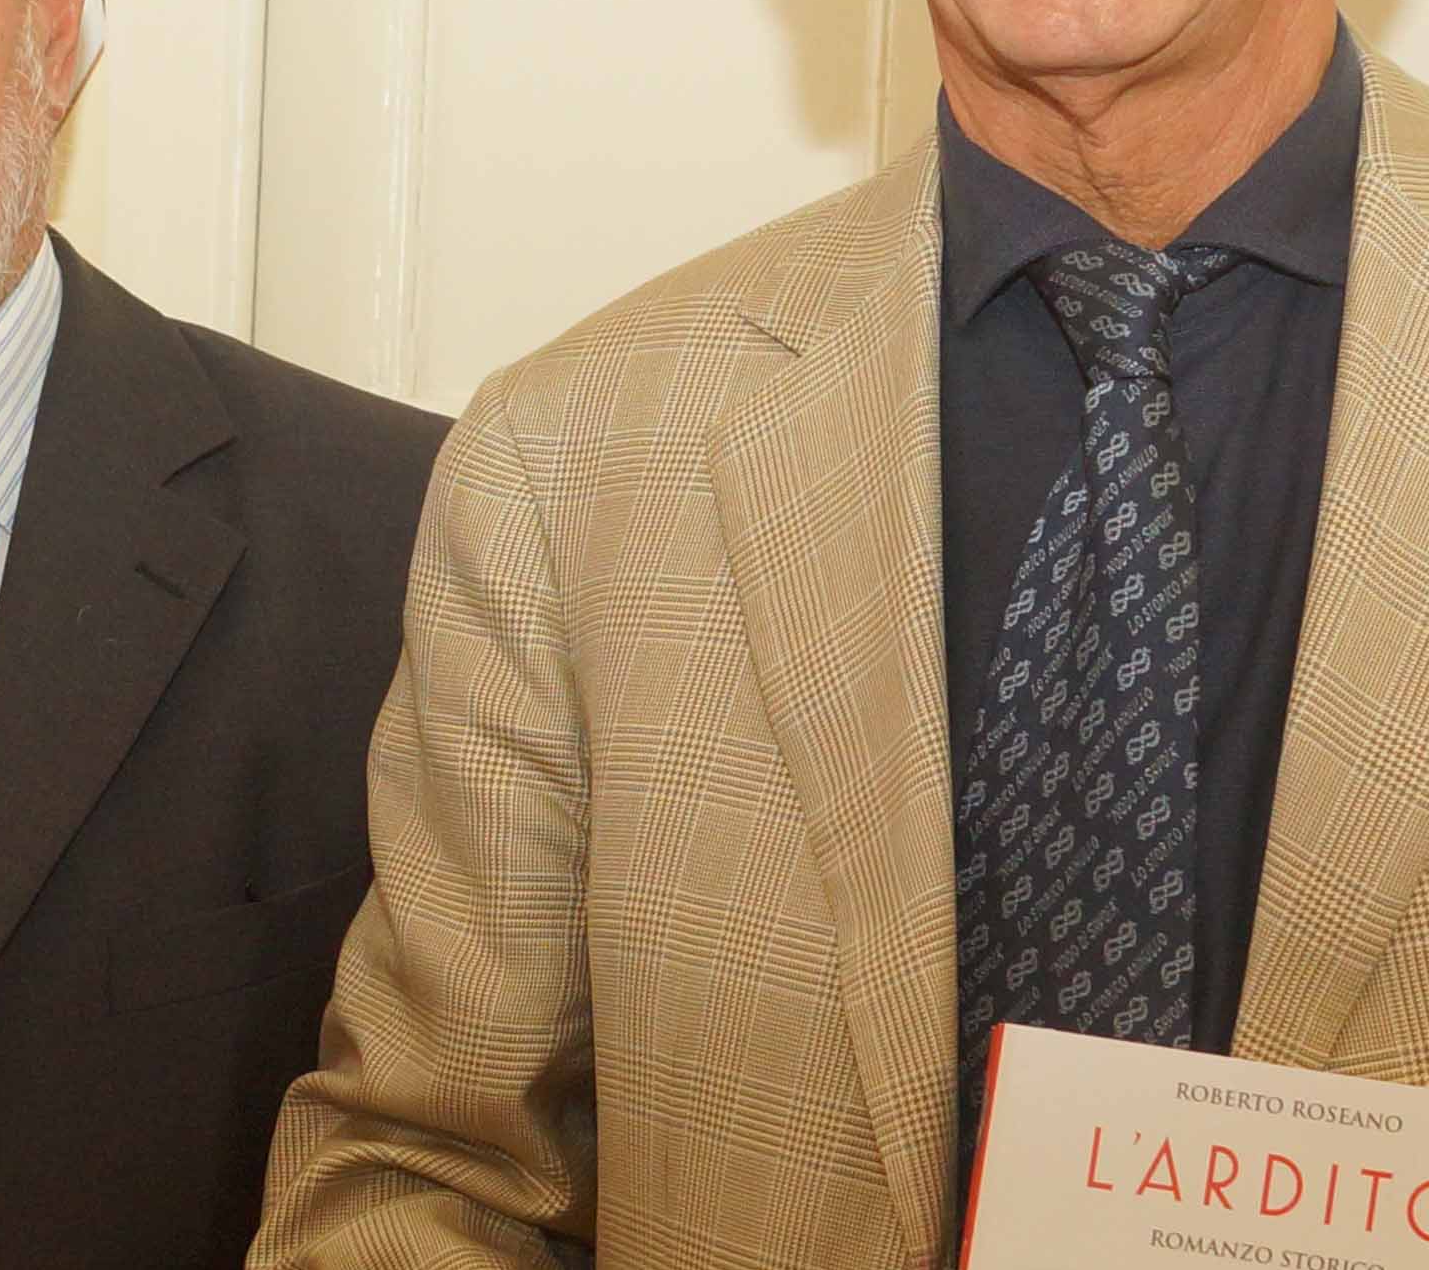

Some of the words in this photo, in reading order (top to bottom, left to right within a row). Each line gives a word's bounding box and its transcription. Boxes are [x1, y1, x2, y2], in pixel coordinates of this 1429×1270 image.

[1175, 1081, 1285, 1119] ROBERTO
[1292, 1098, 1404, 1134] ROSEANO
[1150, 1228, 1273, 1266] ROMANZO
